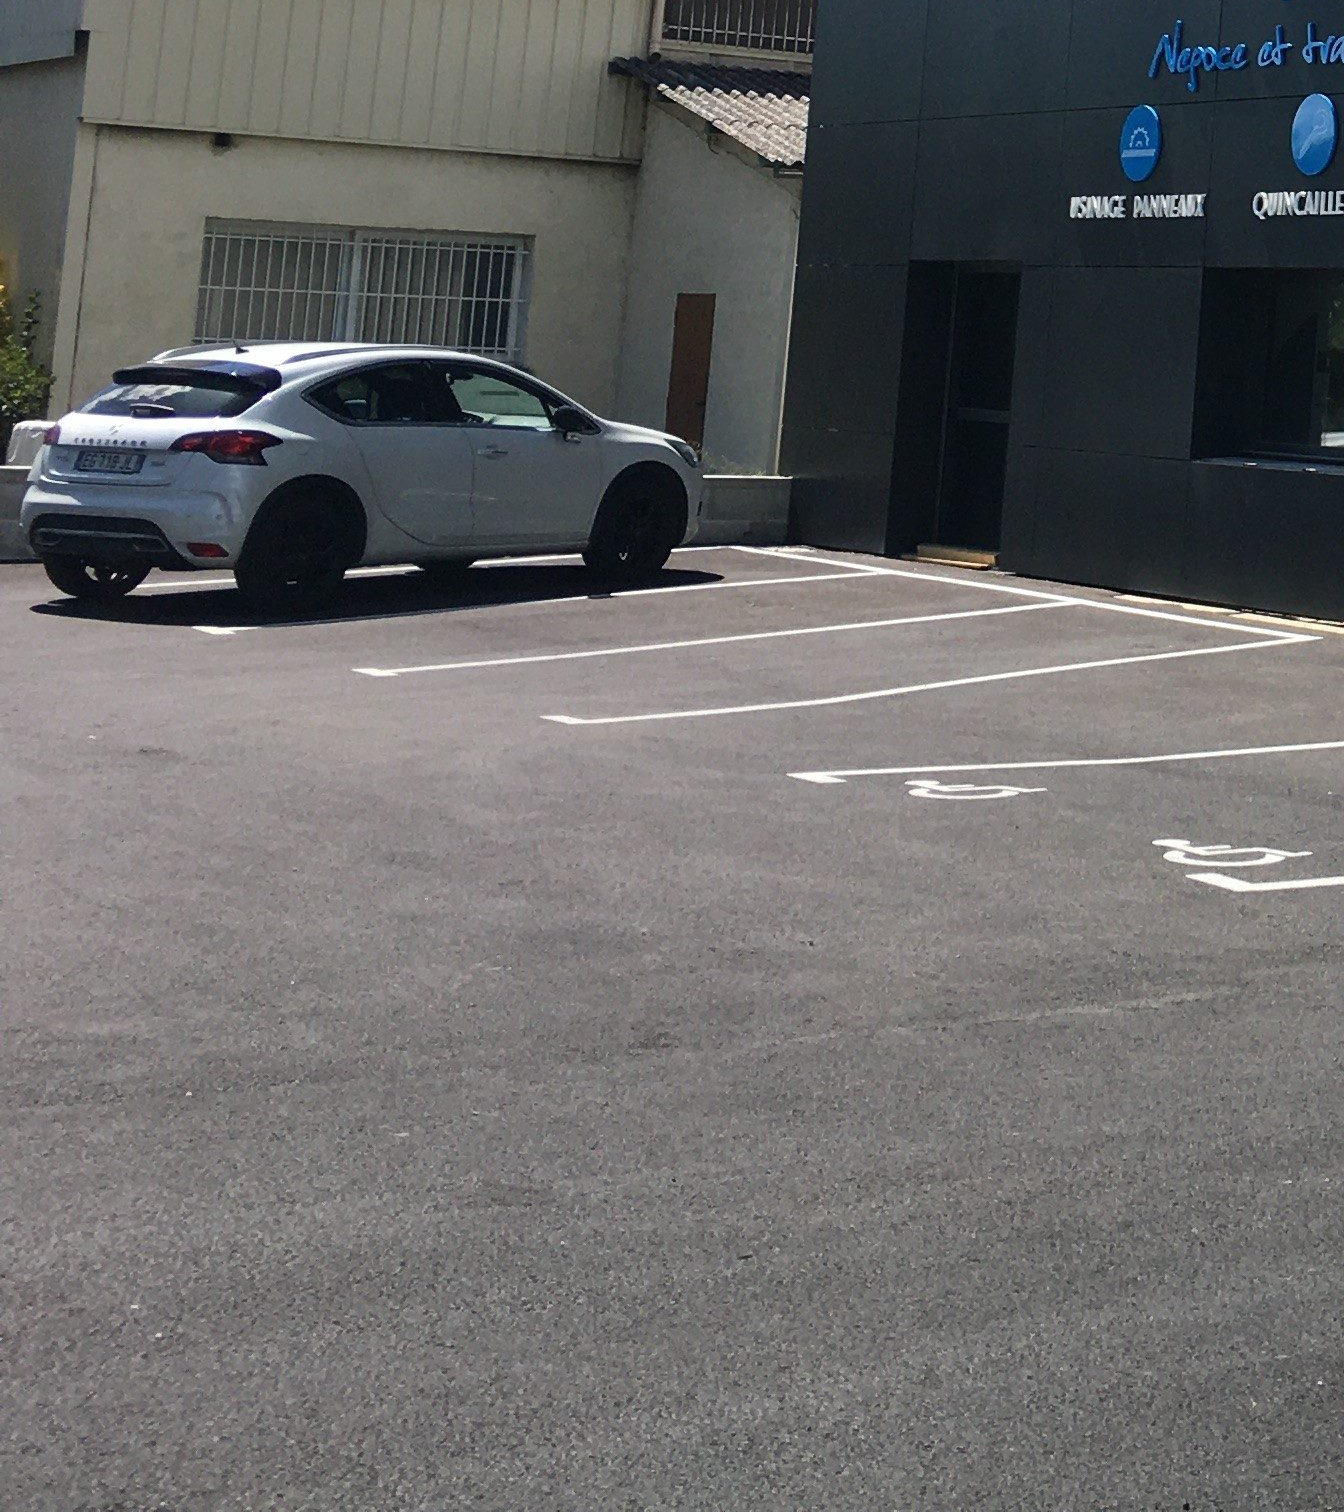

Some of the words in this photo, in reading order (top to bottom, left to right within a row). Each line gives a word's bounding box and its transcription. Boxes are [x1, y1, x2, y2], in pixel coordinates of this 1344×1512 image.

[1257, 25, 1293, 67] et
[1070, 195, 1127, 218] USINAGE
[1133, 193, 1206, 218] PANNEAUX
